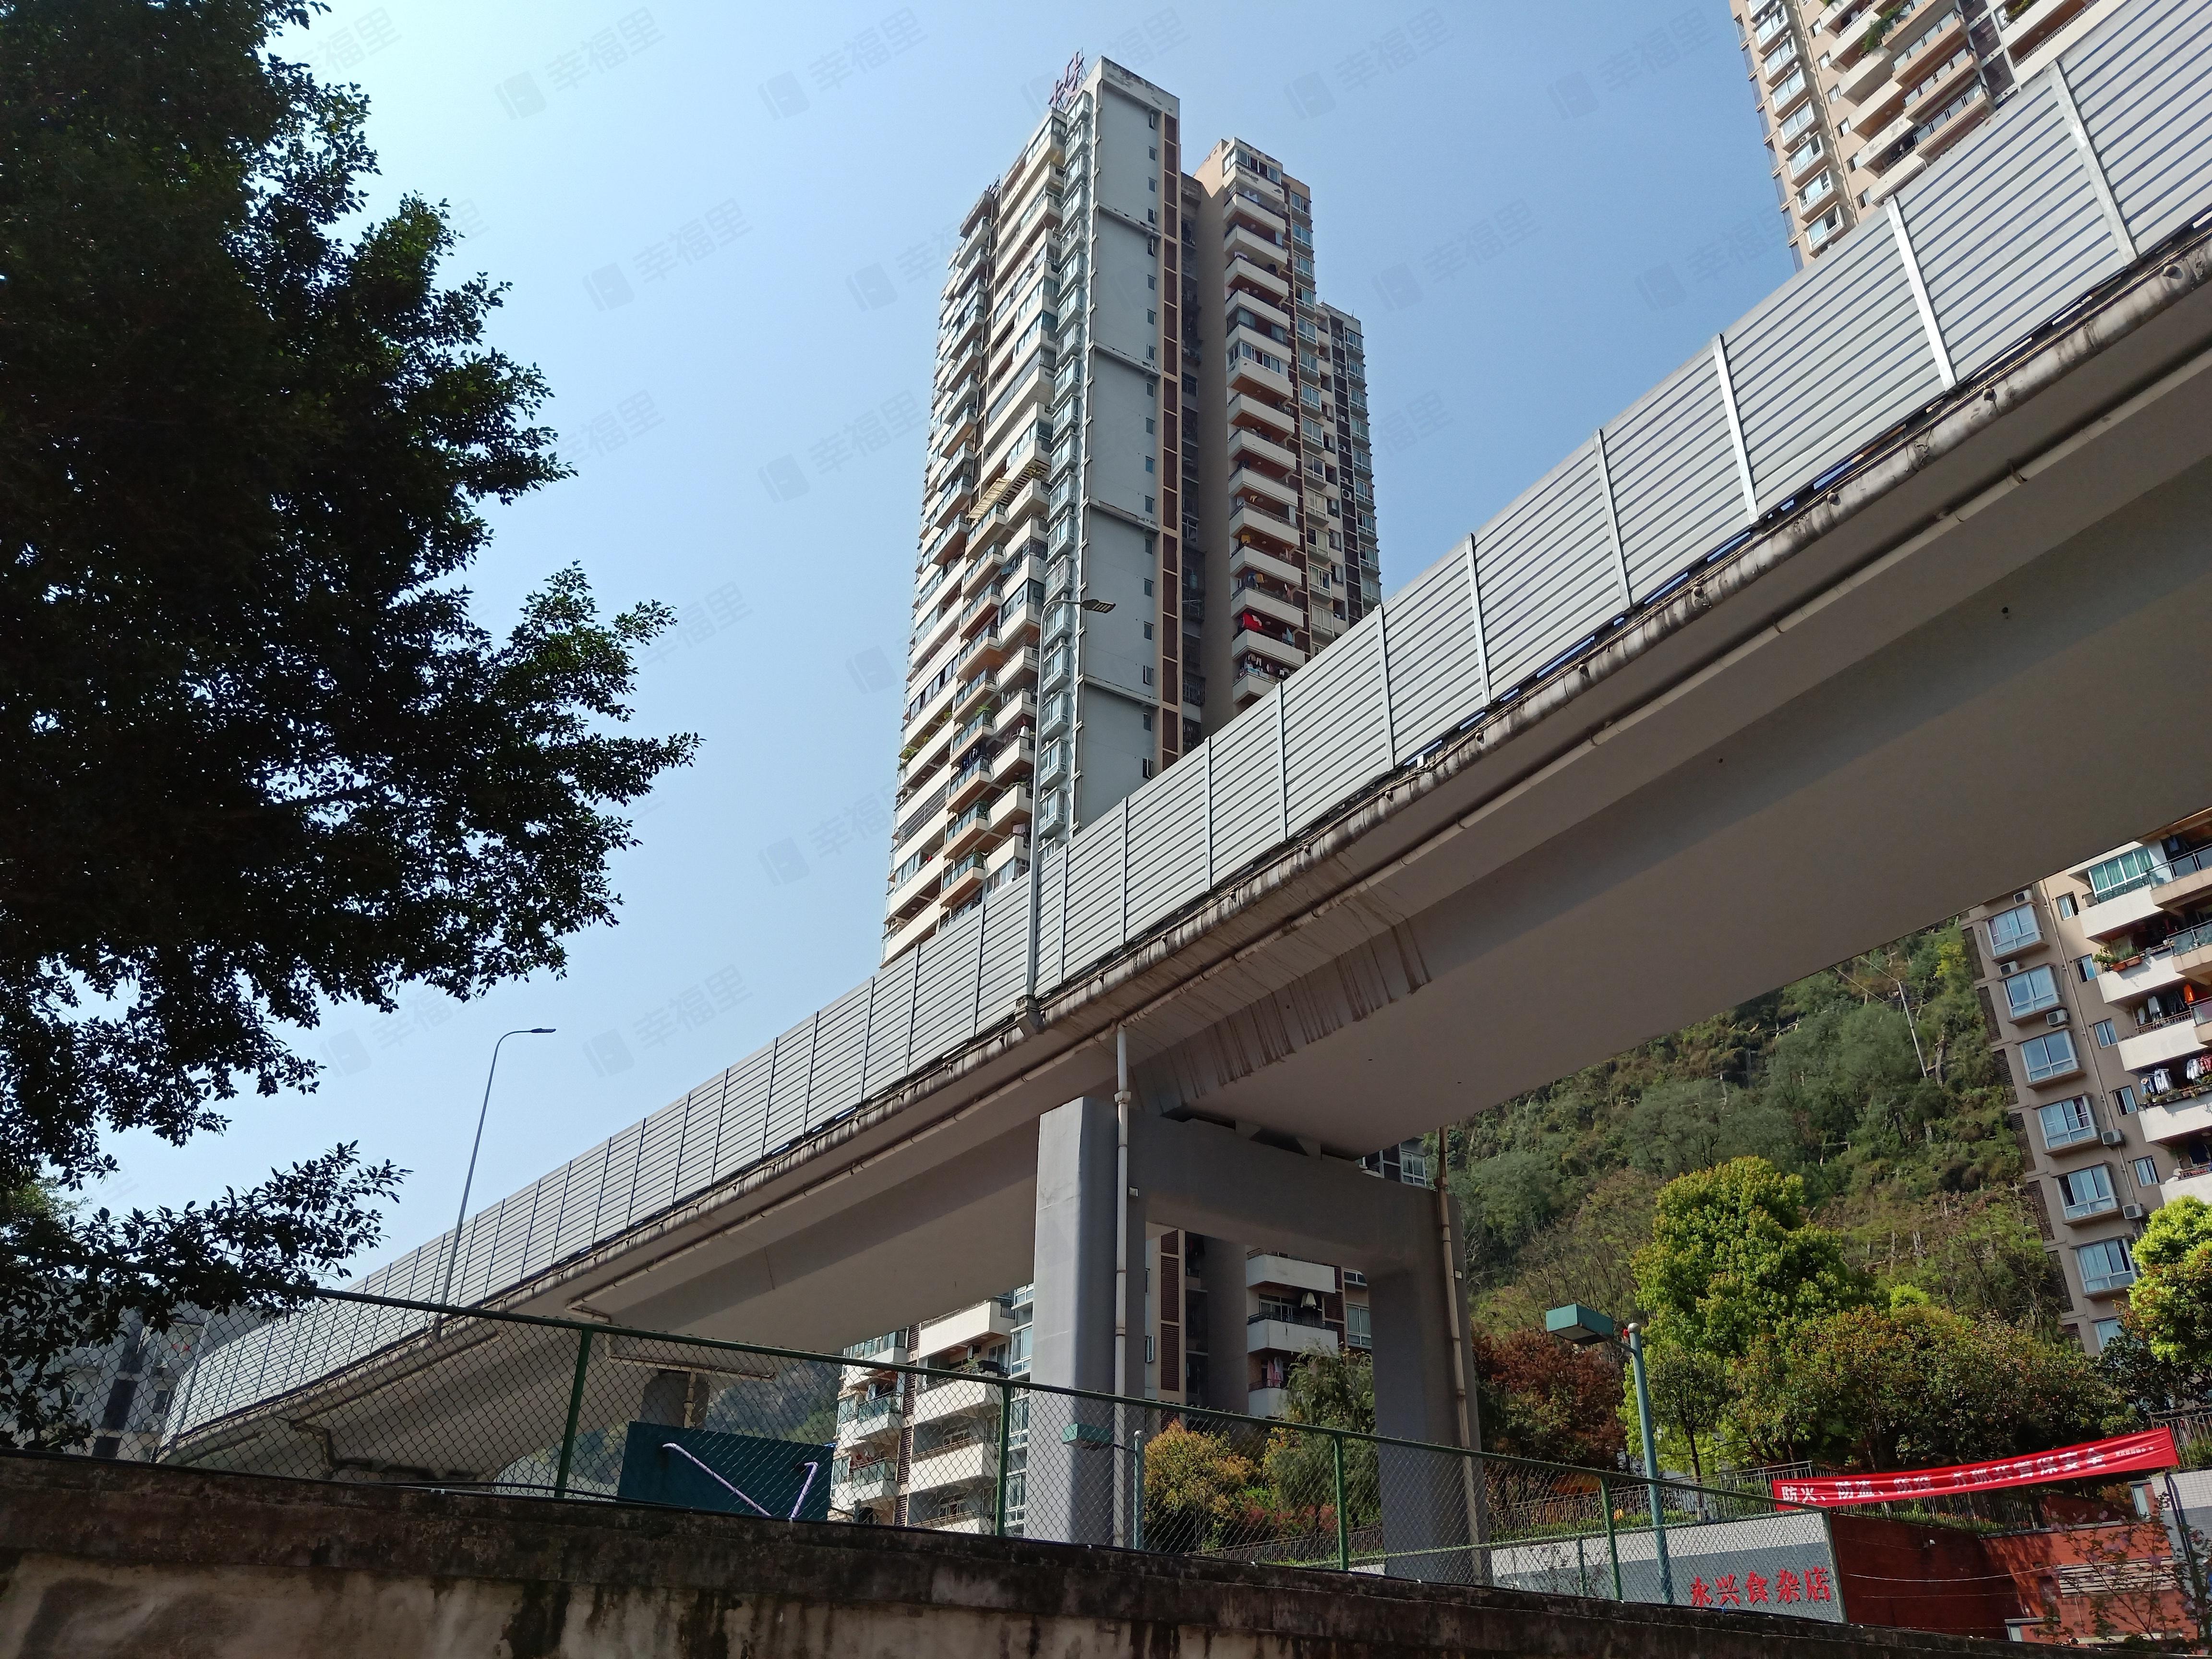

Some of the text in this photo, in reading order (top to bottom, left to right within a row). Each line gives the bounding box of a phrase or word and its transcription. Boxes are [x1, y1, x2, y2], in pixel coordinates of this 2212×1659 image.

[1690, 1566, 1831, 1607] 永兴食杂店
